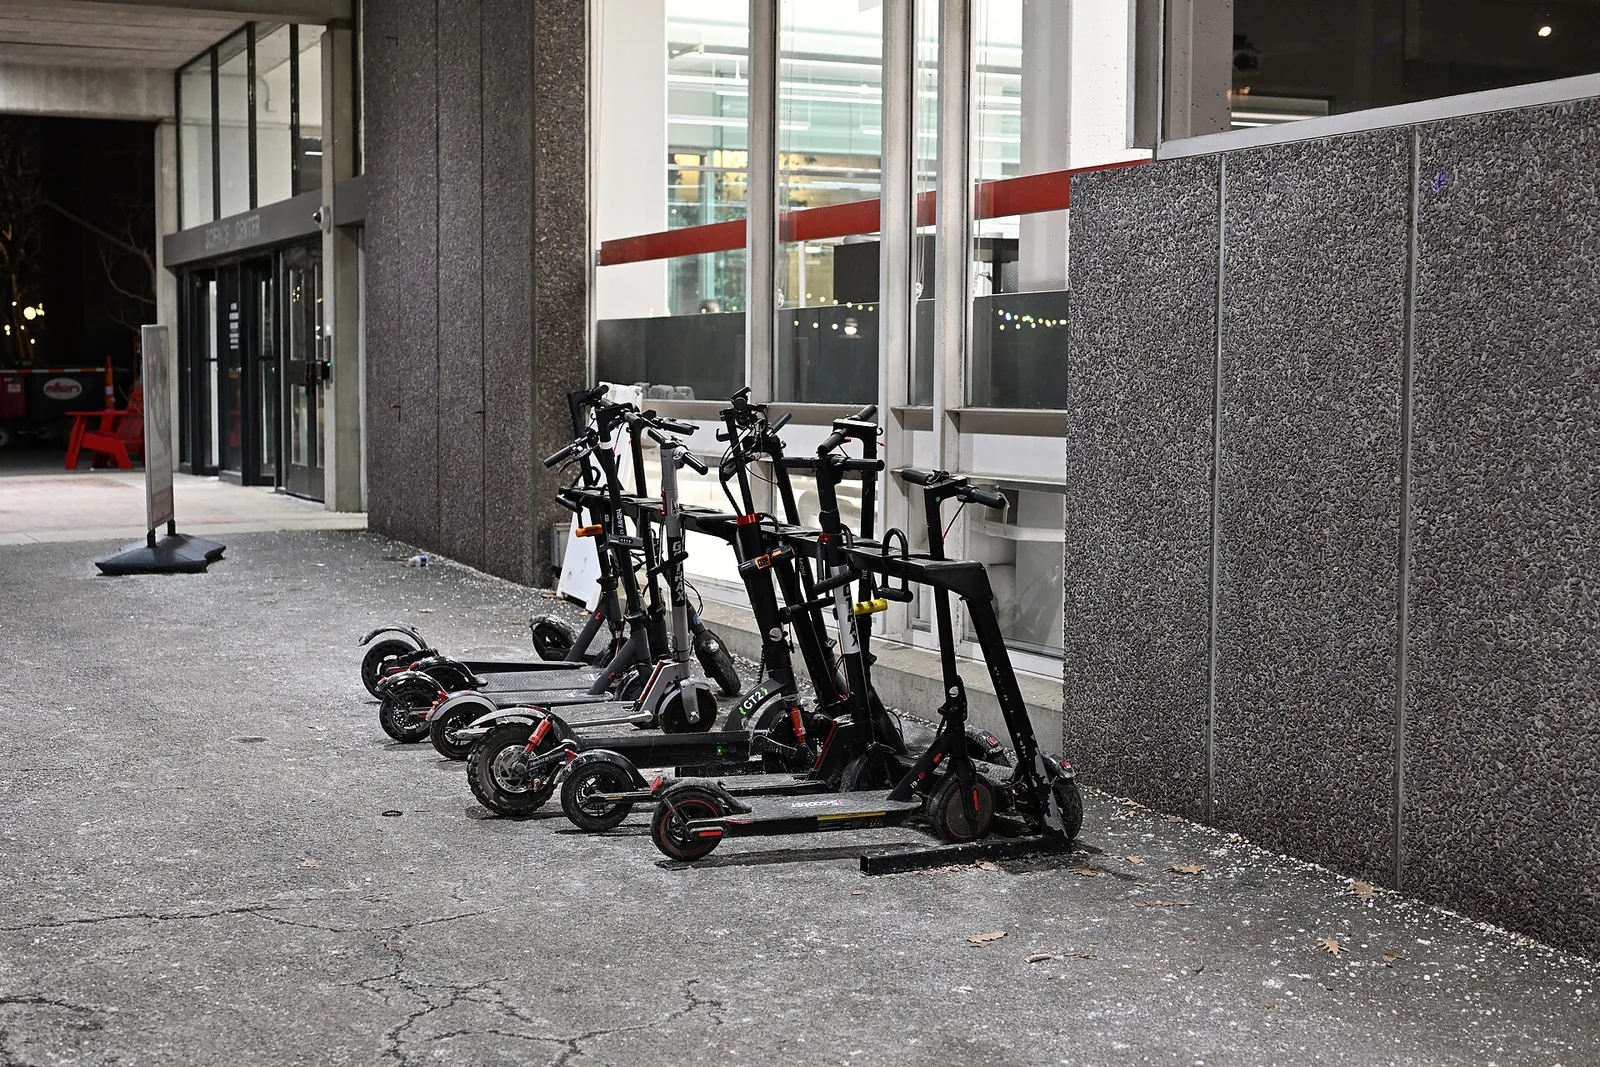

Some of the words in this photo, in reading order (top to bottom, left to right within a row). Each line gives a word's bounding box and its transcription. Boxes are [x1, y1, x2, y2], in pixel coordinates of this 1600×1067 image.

[235, 214, 260, 240] CENTER
[843, 583, 859, 647] OTRAX
[743, 691, 764, 710] GT2
